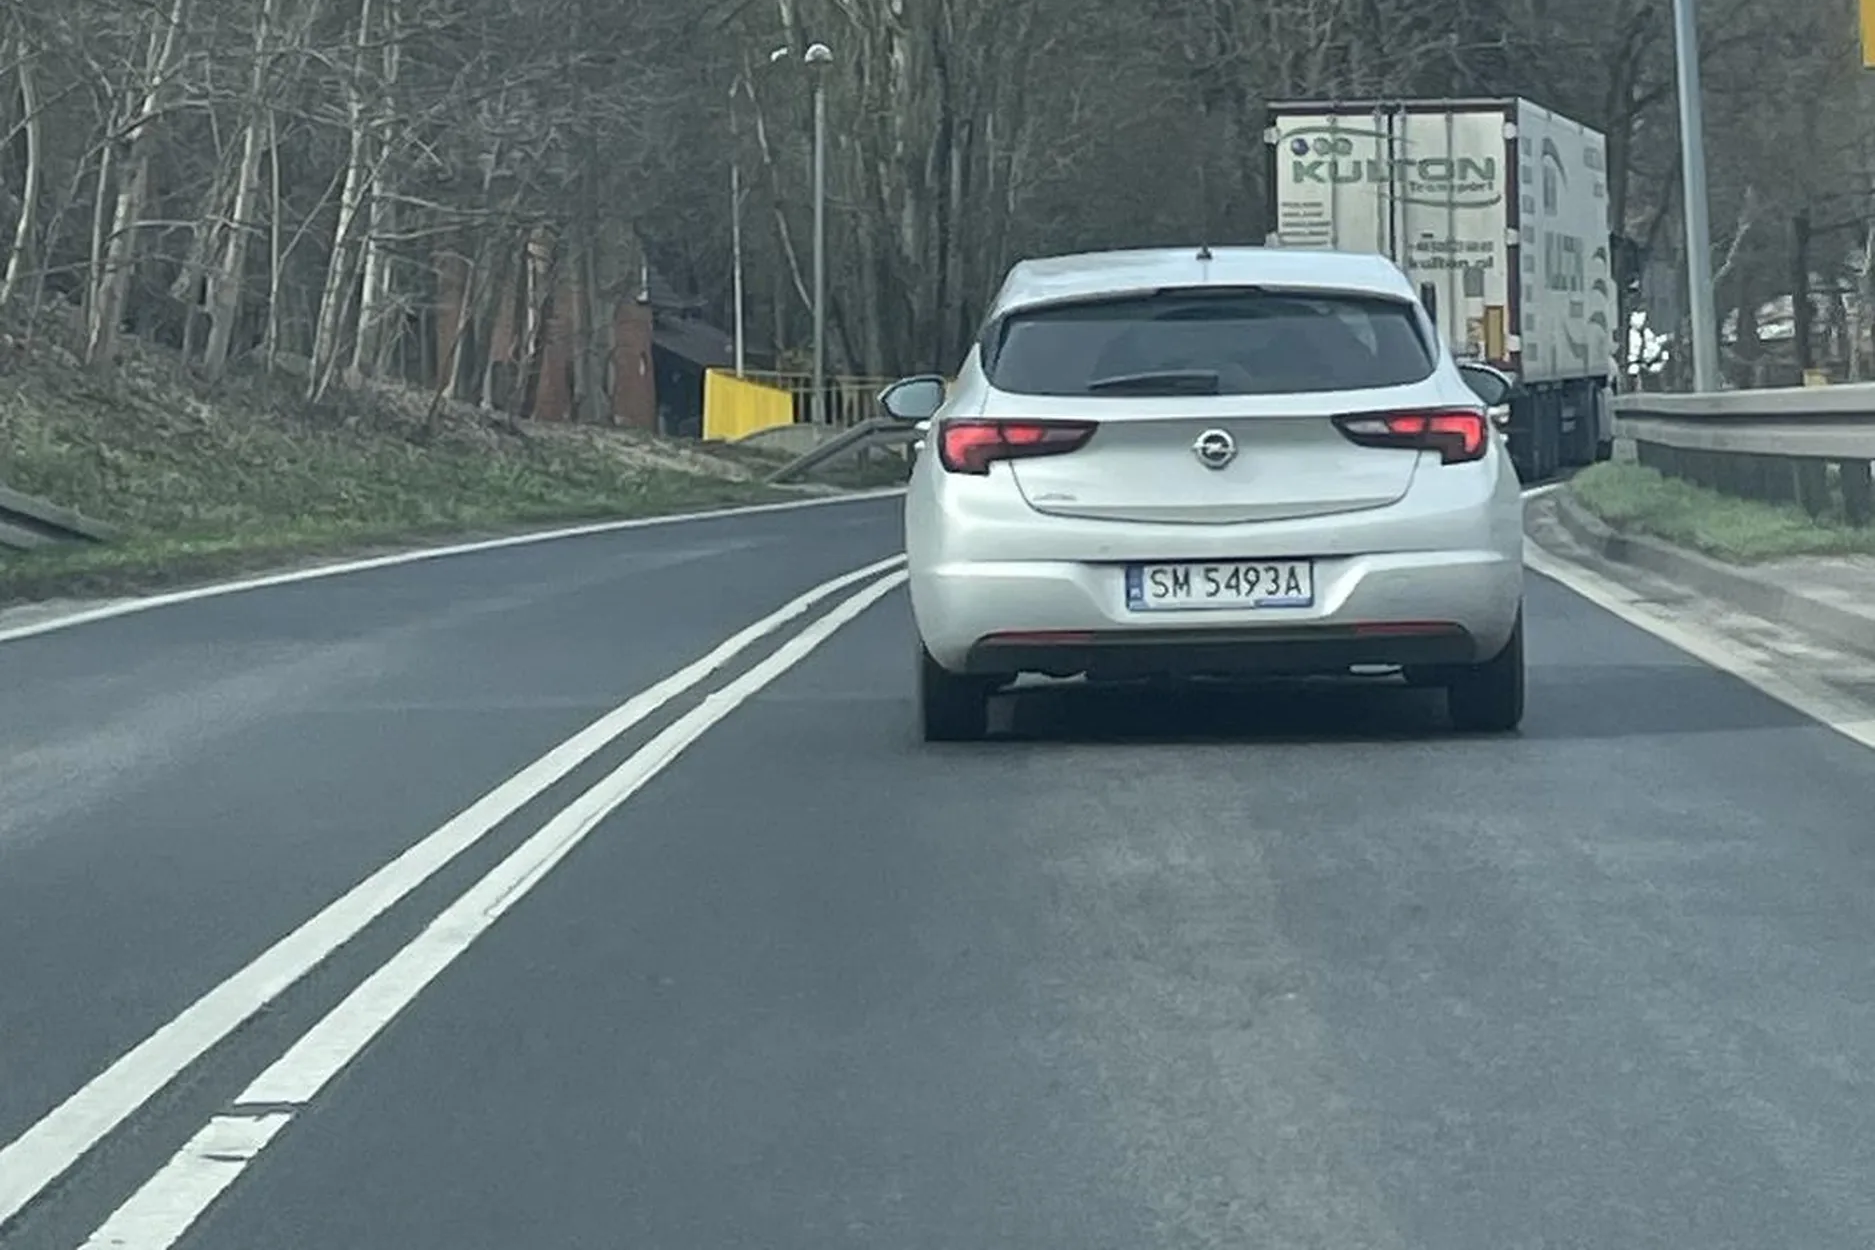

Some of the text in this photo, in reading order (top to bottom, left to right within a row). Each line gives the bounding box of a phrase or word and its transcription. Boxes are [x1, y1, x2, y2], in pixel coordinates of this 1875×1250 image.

[1292, 157, 1496, 184] KULTON
[1150, 565, 1302, 599] SM 5493A
